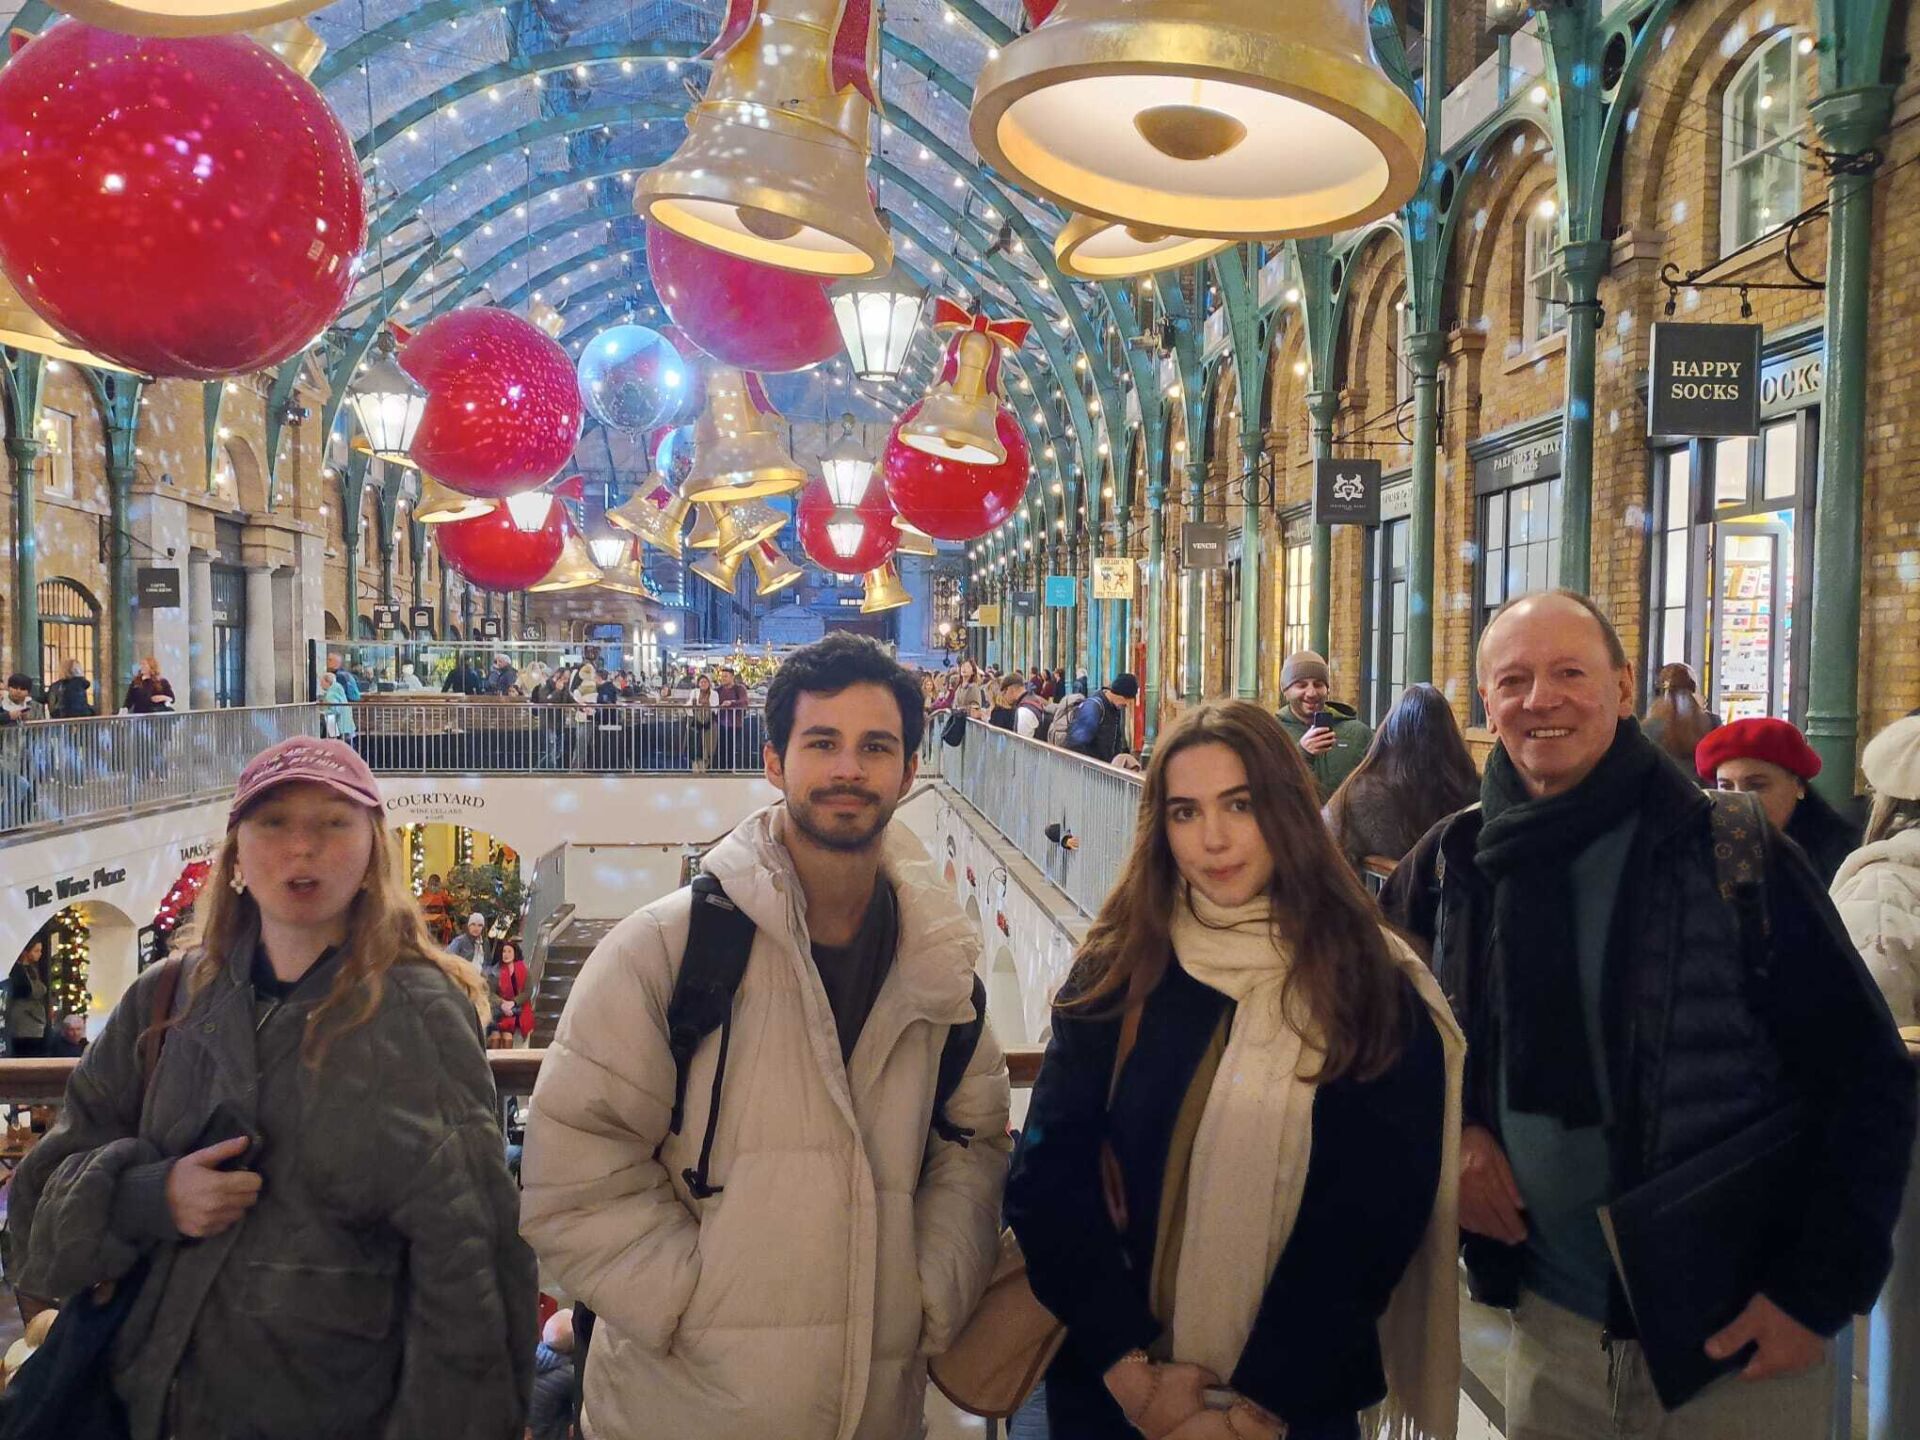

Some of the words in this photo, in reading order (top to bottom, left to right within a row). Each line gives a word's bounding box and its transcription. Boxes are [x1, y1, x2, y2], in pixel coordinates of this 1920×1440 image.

[1671, 361, 1741, 378] HAPPY
[1671, 383, 1740, 400] SOCKS
[1762, 362, 1821, 405] OCKS
[386, 792, 485, 810] COURTYARD
[410, 807, 429, 815] WINE
[180, 844, 203, 861] TAPAS
[25, 885, 53, 909] The
[55, 876, 91, 900] Wine
[92, 867, 127, 889] Place
